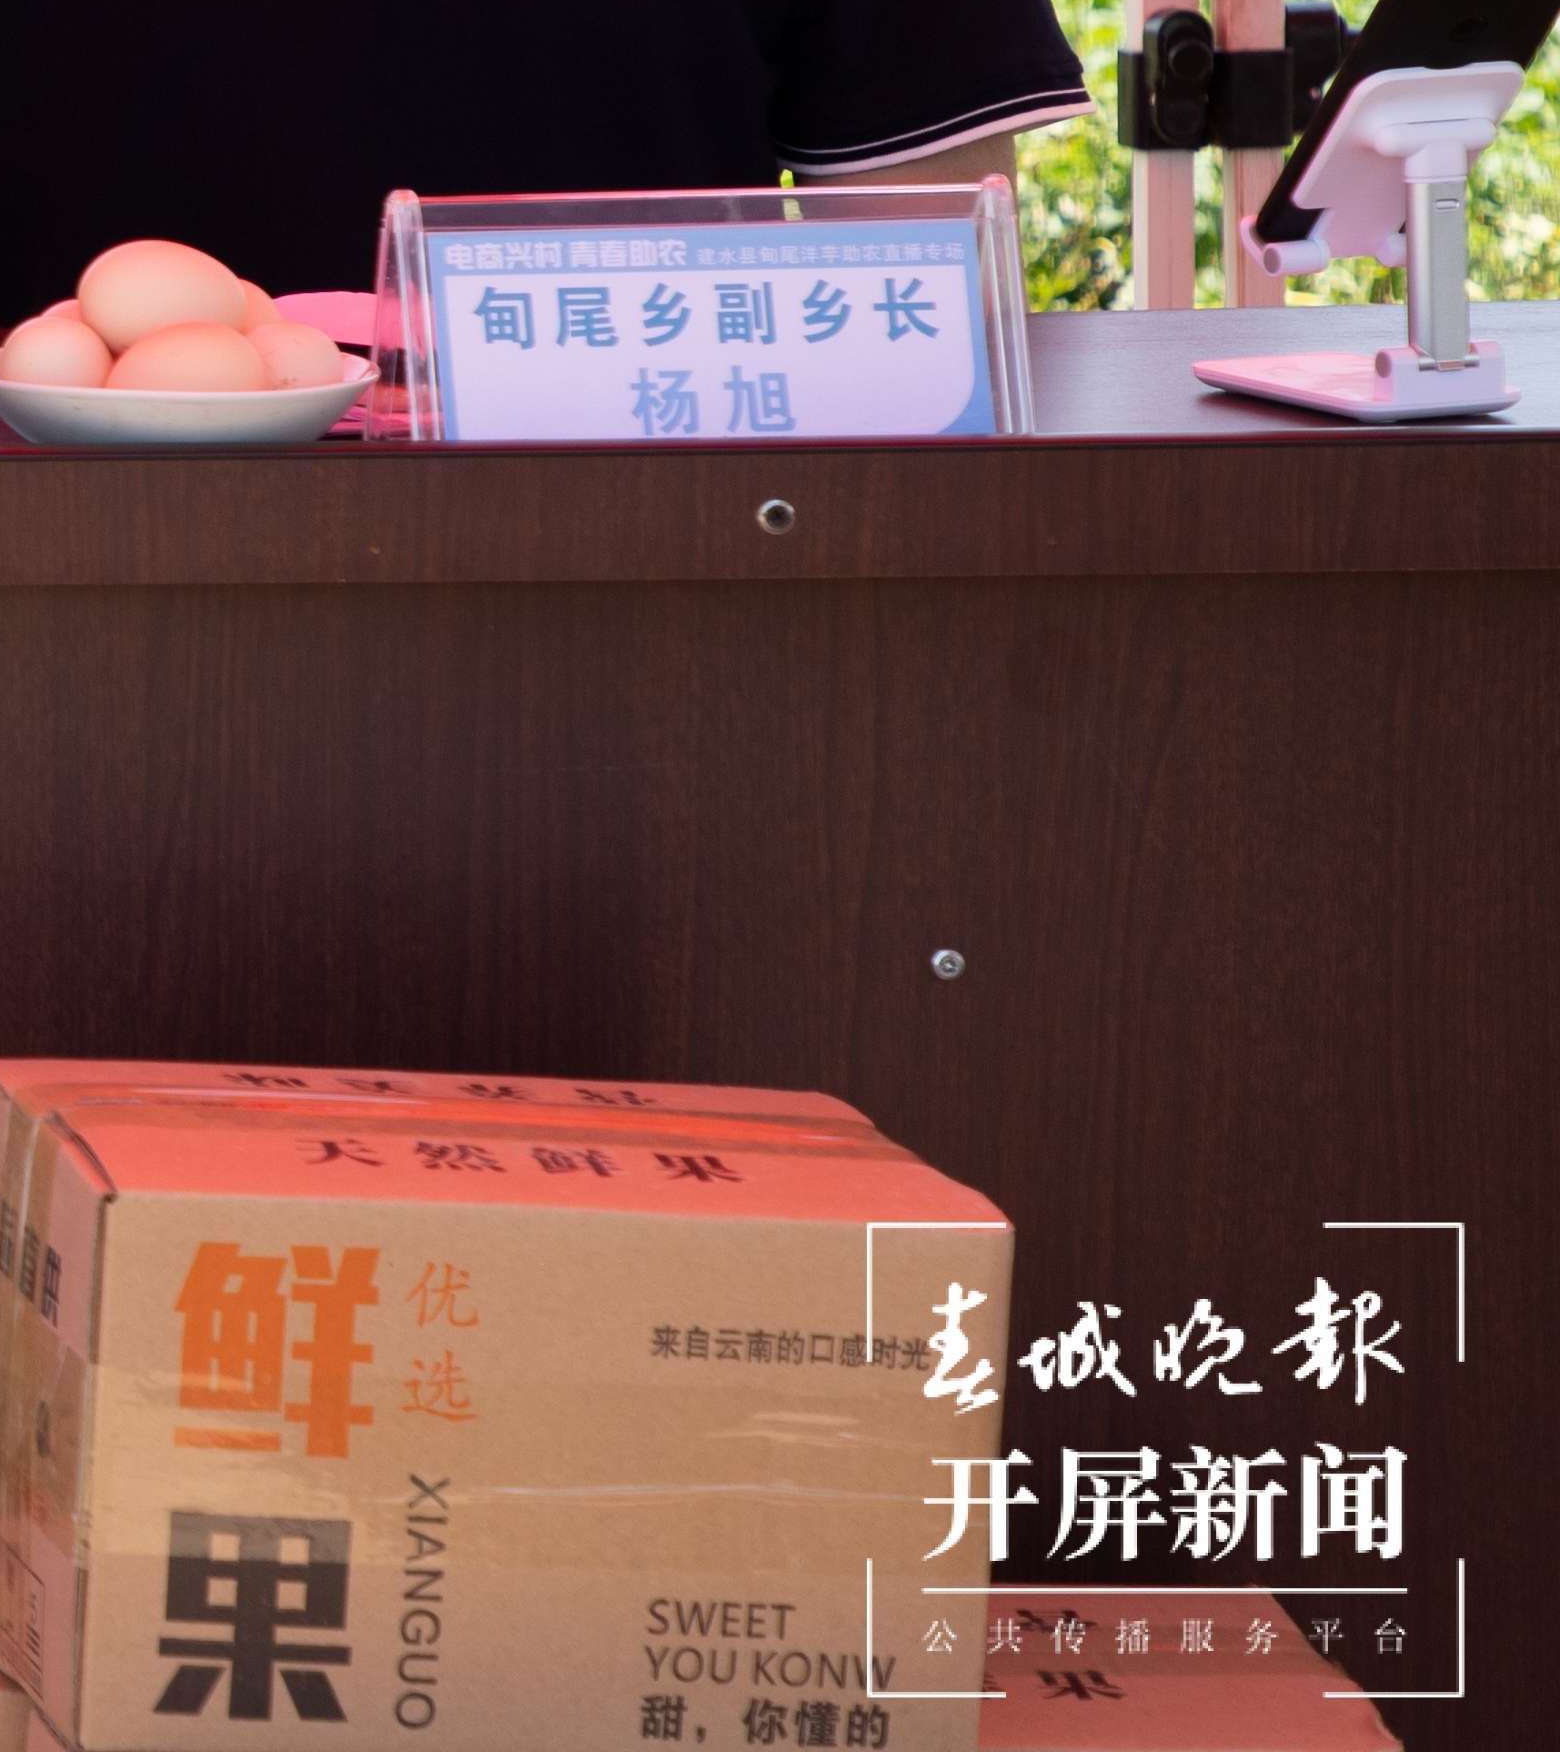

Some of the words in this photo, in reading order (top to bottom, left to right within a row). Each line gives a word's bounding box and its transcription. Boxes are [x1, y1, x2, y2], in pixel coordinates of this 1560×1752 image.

[445, 242, 562, 270] 电商兴村
[570, 240, 686, 268] 青春助农
[474, 278, 941, 350] 甸尾乡副乡长
[630, 364, 798, 437] 杨旭
[296, 1137, 744, 1183] 天然鲜果
[400, 1260, 480, 1423] 优选
[650, 1324, 933, 1372] 来自云南的口感时光
[393, 1472, 452, 1731] XIANGUO
[645, 1598, 796, 1641] SWEET
[643, 1645, 738, 1685] YOU
[752, 1650, 897, 1692] KONW
[639, 1693, 891, 1748] 甜，你懂的
